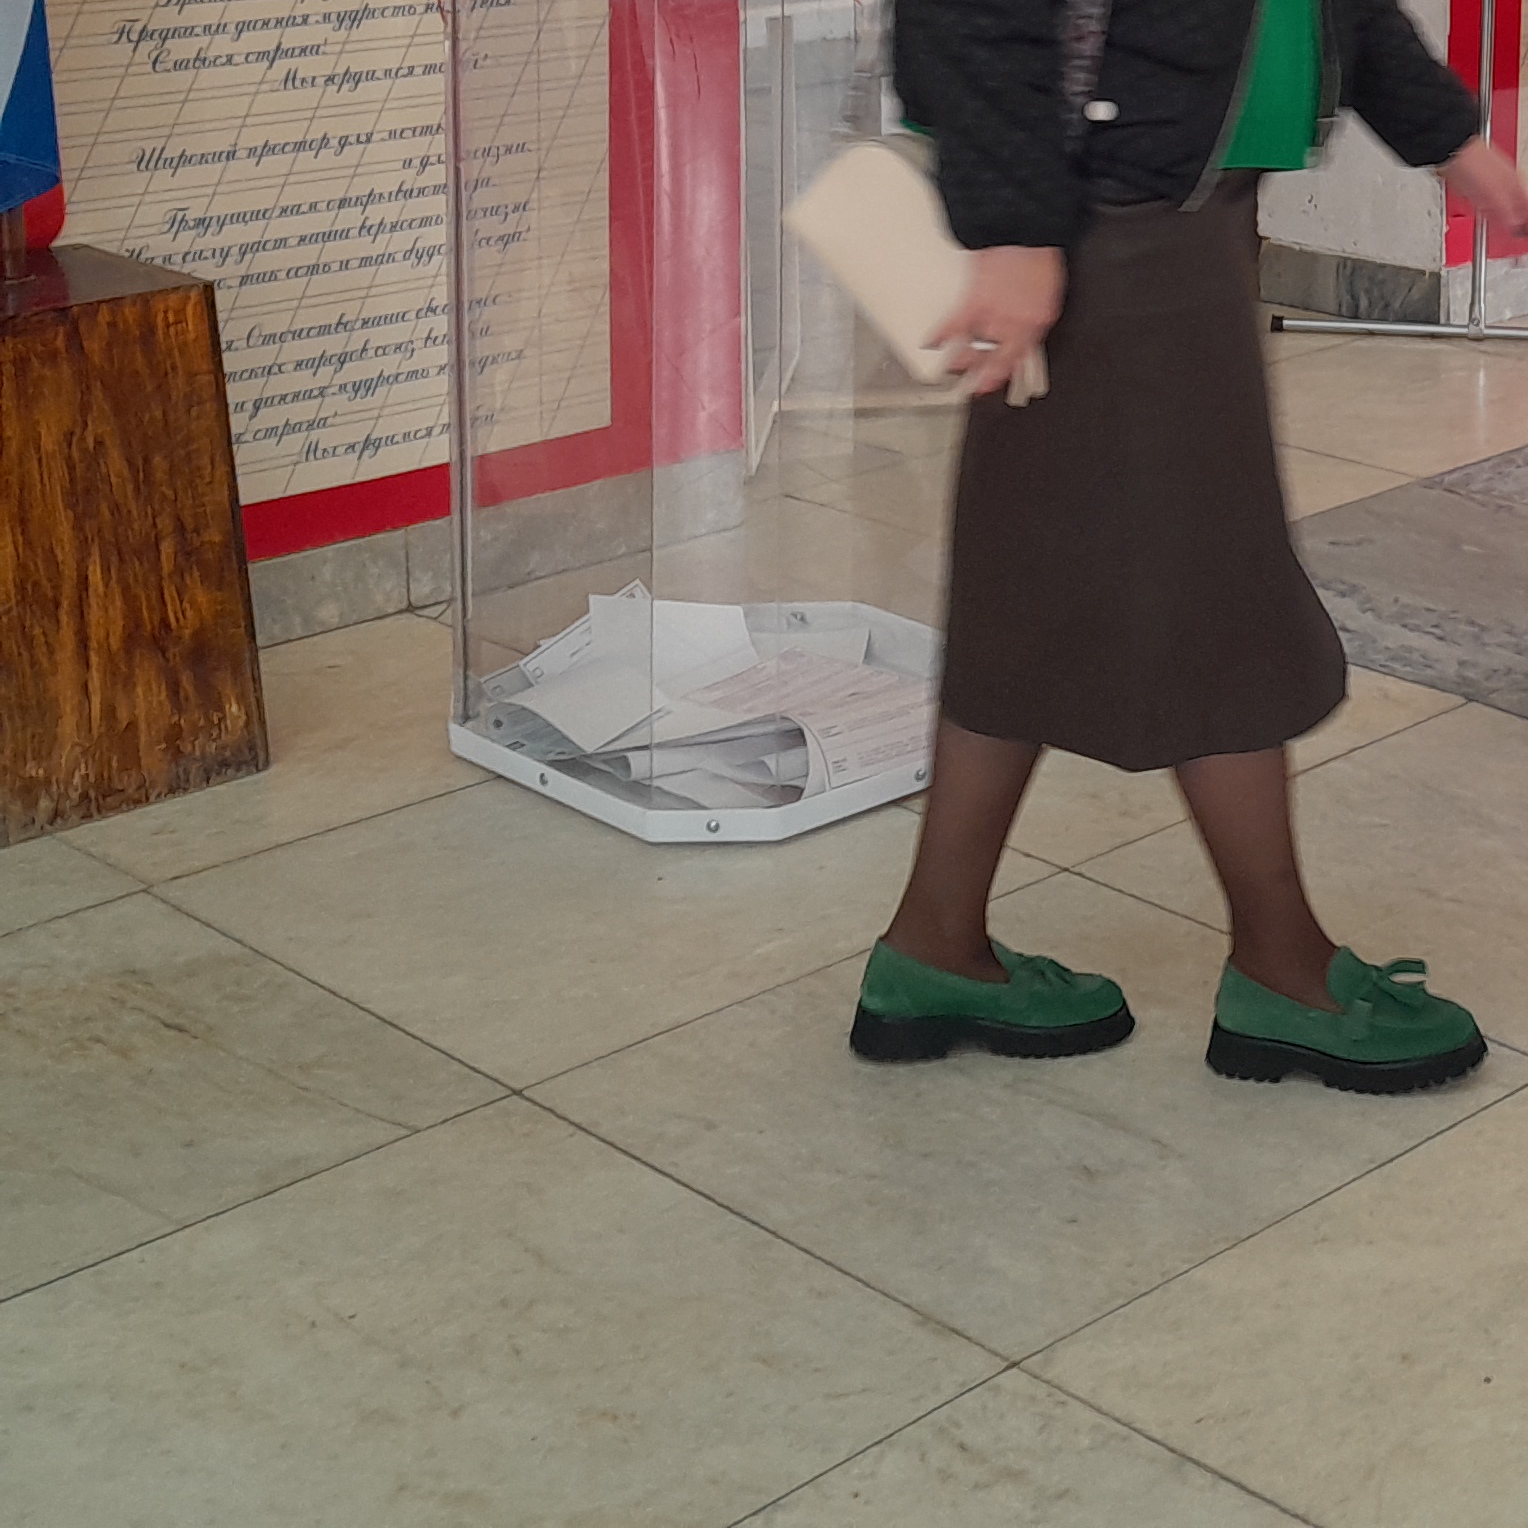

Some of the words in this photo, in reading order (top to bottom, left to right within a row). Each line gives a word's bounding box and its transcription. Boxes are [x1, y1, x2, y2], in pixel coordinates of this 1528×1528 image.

[112, 18, 228, 54] Предками
[230, 13, 310, 43] данная
[315, 2, 417, 32] мудрость
[283, 66, 316, 91] Мы
[323, 65, 415, 94] гордимся
[134, 141, 239, 178] Широкий
[245, 132, 331, 169] простор
[334, 129, 374, 157] для
[279, 199, 319, 219] нам
[181, 246, 232, 268] силу
[298, 227, 350, 247] наша
[238, 273, 279, 288] так
[338, 256, 351, 271] и
[357, 251, 398, 270] так
[246, 312, 353, 348] Отечество
[360, 310, 412, 329] наше
[293, 337, 371, 377] народов
[250, 385, 330, 422] данная
[331, 367, 430, 403] мудрость
[305, 437, 340, 463] Мы
[343, 421, 434, 463] гордимся
